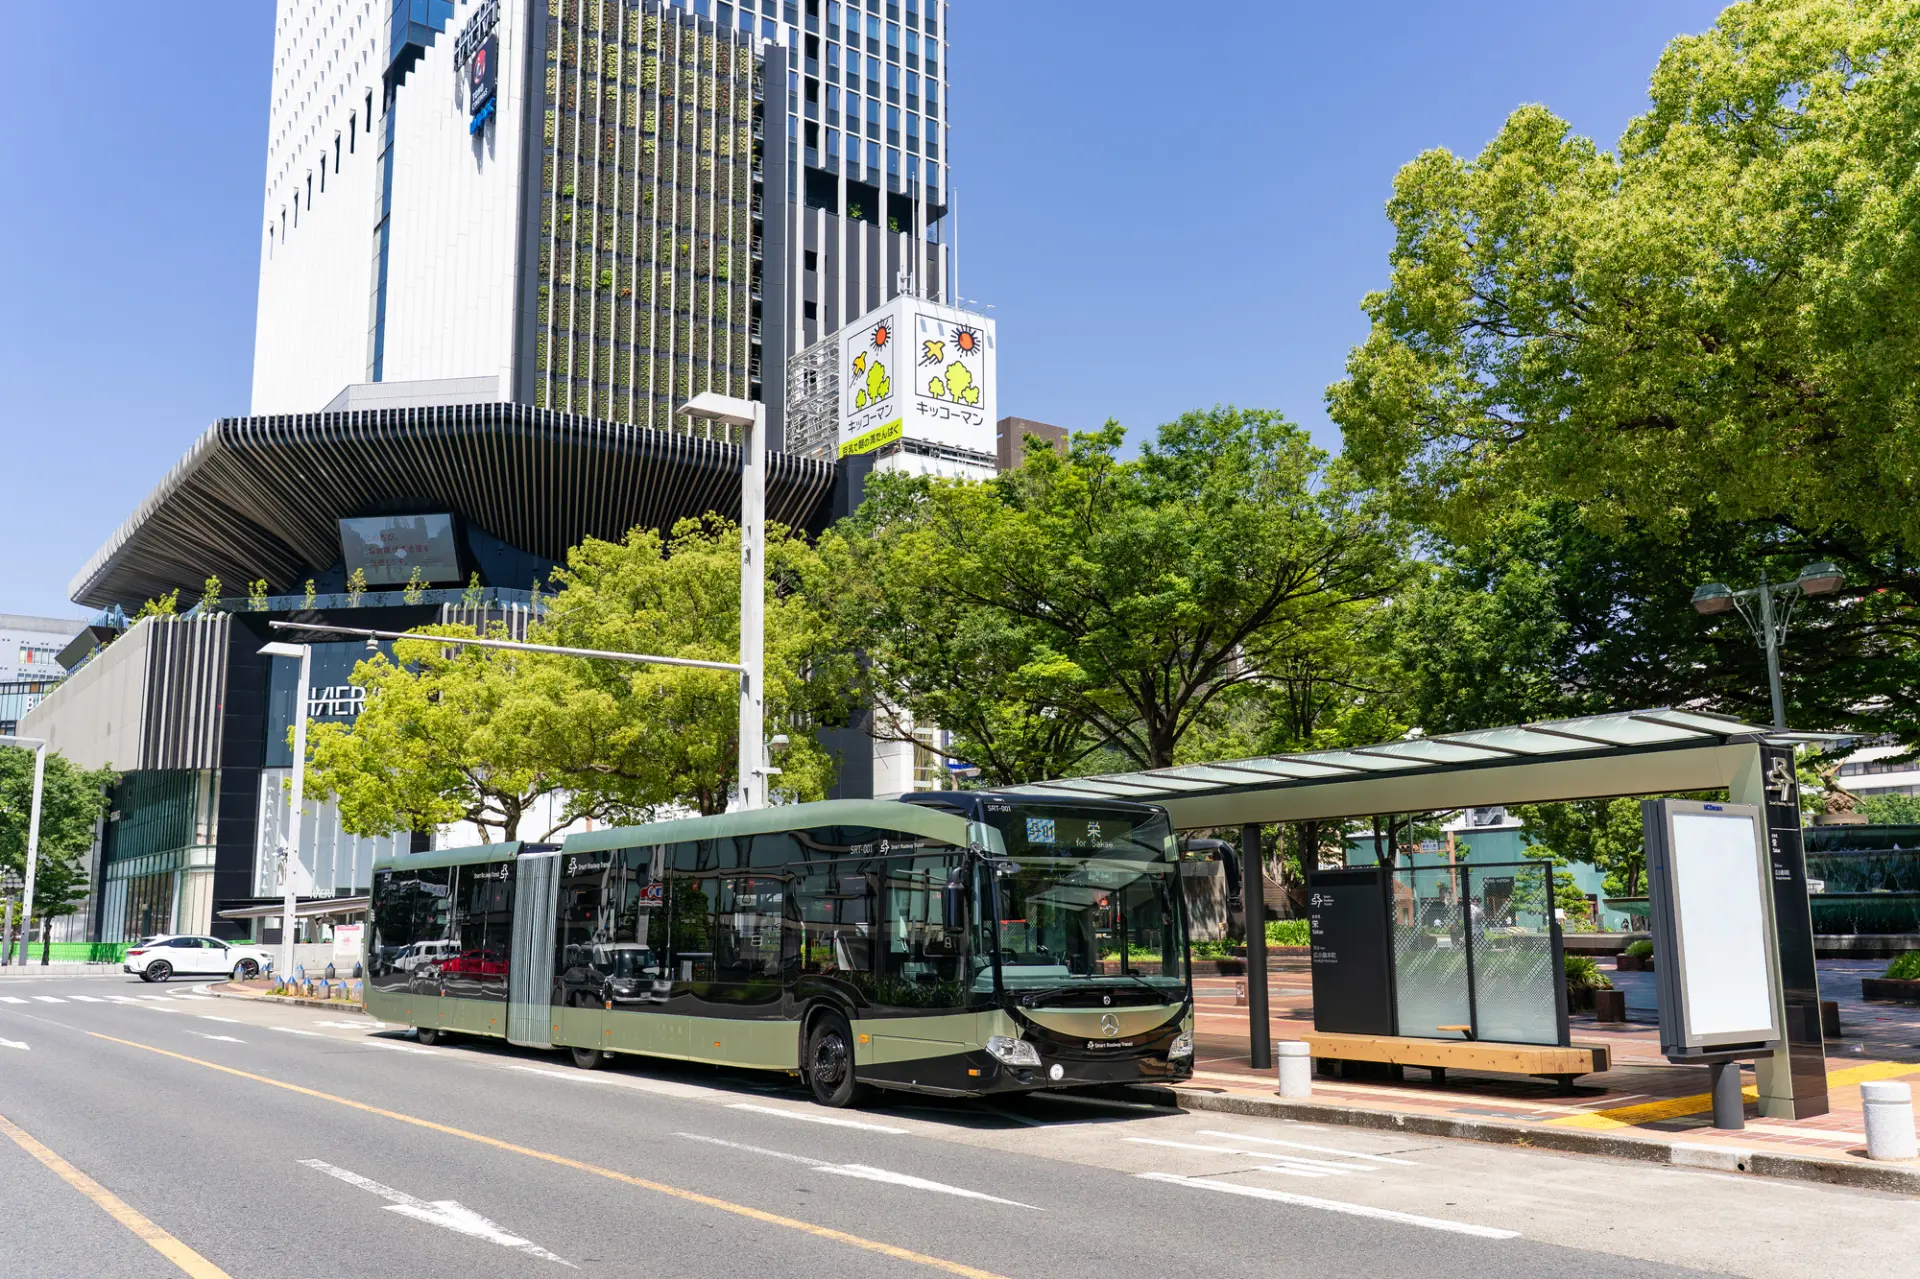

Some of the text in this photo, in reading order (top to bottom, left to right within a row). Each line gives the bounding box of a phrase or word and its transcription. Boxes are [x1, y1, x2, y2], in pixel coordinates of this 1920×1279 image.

[847, 404, 893, 433] キッコーマン
[915, 401, 984, 426] キッコーマン
[987, 804, 1012, 812] SRT-001
[1087, 821, 1101, 838] 栄
[850, 844, 873, 855] SRT-001
[1076, 838, 1114, 850] for Sakae
